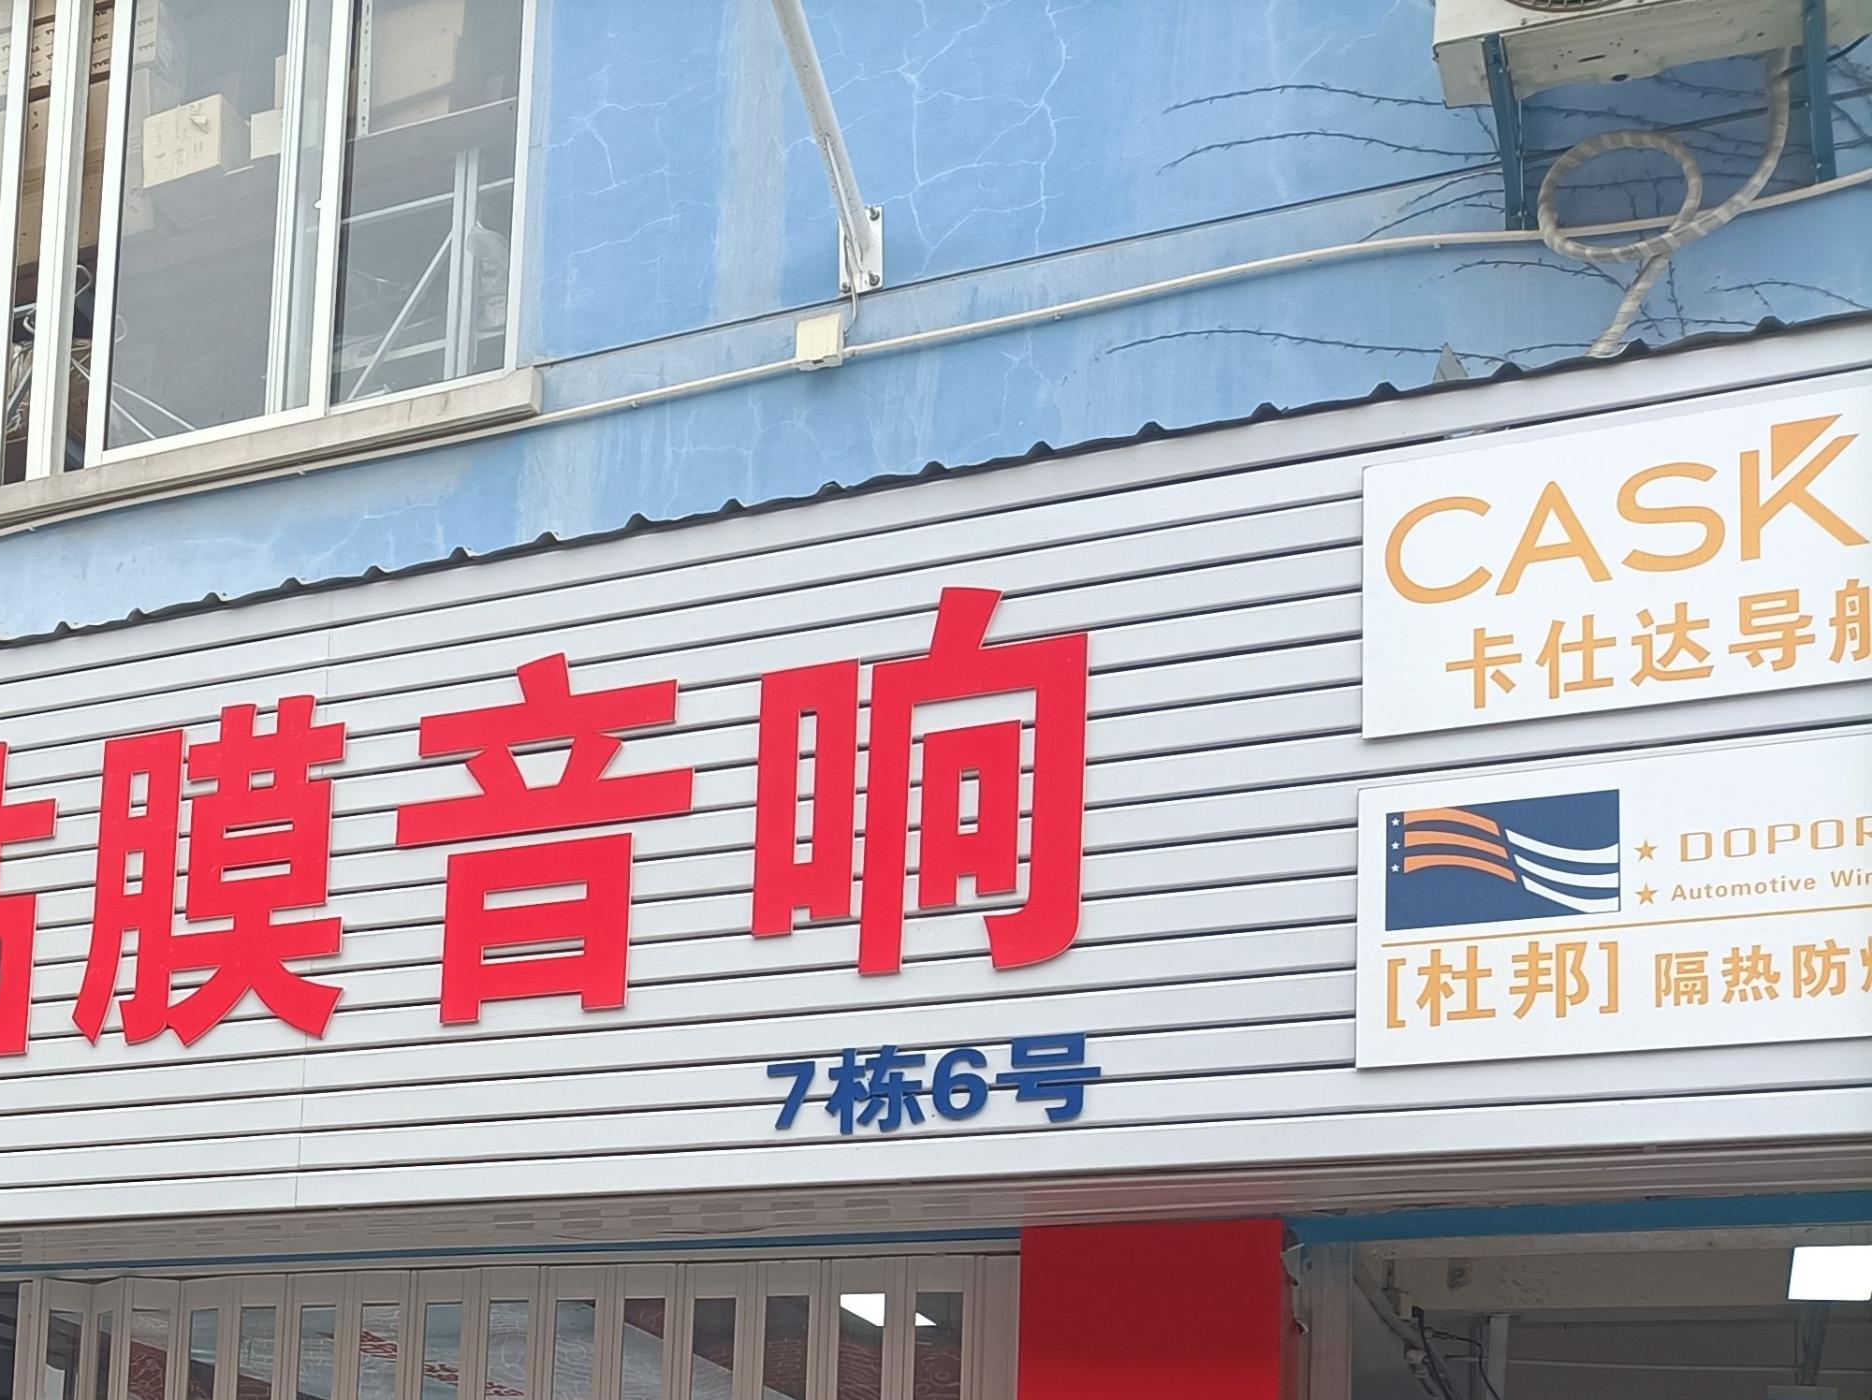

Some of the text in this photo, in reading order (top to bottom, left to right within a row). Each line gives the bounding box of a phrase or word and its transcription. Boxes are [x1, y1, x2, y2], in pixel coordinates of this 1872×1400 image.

[1384, 413, 1871, 605] CASK
[1671, 875, 1817, 901] Automotive
[1654, 936, 1872, 1007] 隔热防
[766, 1031, 1102, 1136] 7栋6号
